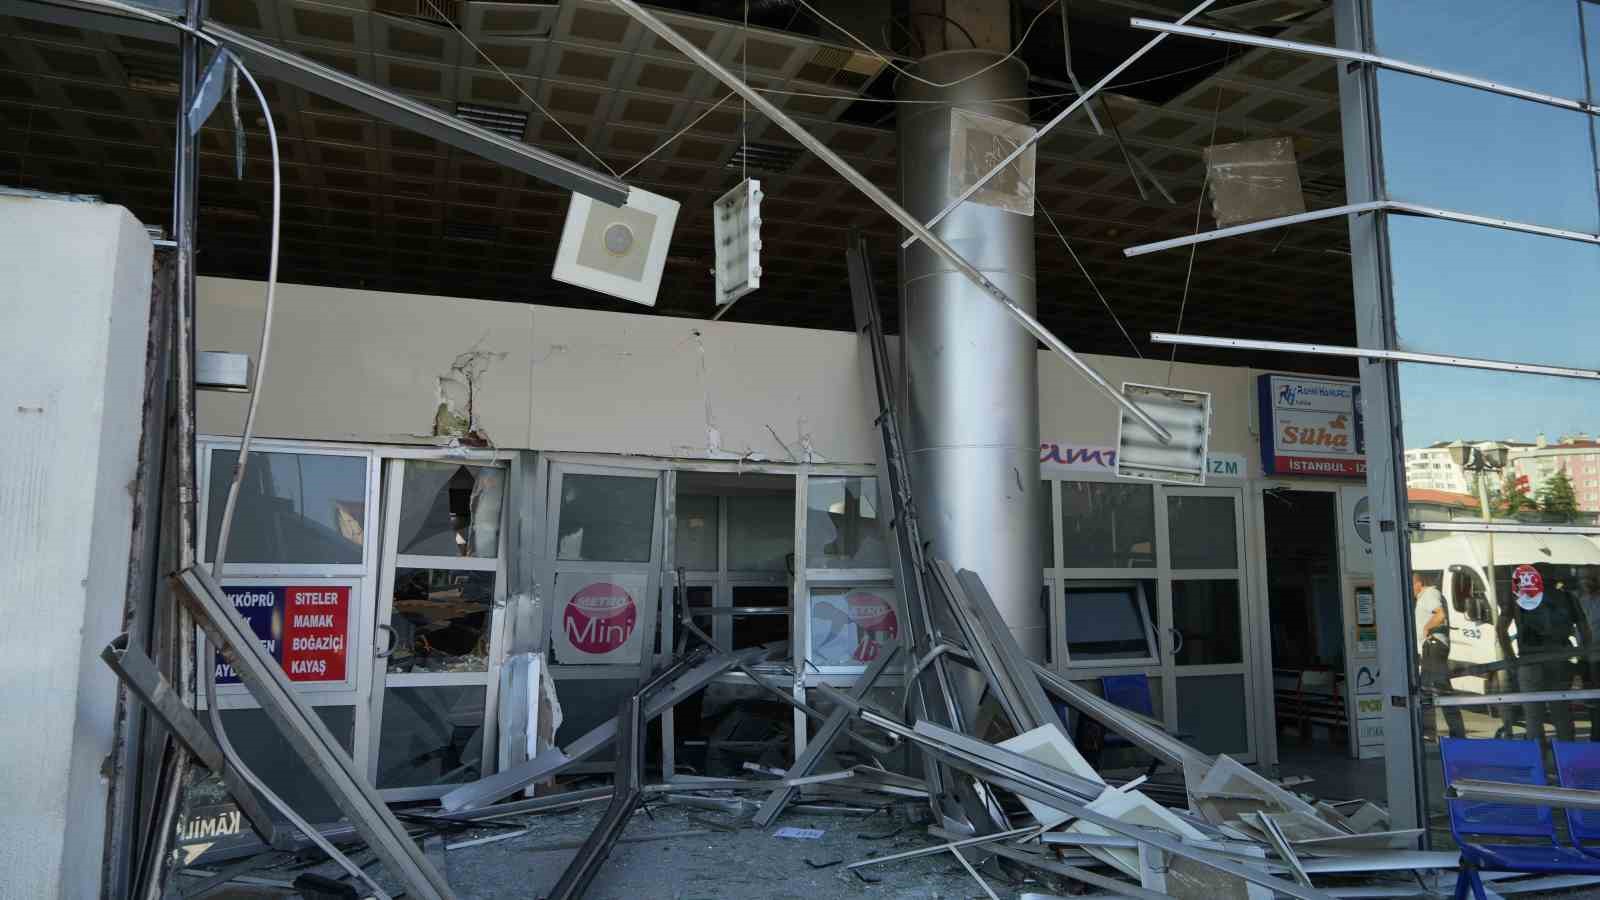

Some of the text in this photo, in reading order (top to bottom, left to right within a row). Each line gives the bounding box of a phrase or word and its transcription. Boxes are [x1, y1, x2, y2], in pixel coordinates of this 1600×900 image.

[293, 615, 334, 628] MAMAK
[566, 616, 633, 643] Mini
[291, 659, 327, 676] KAYAŞ
